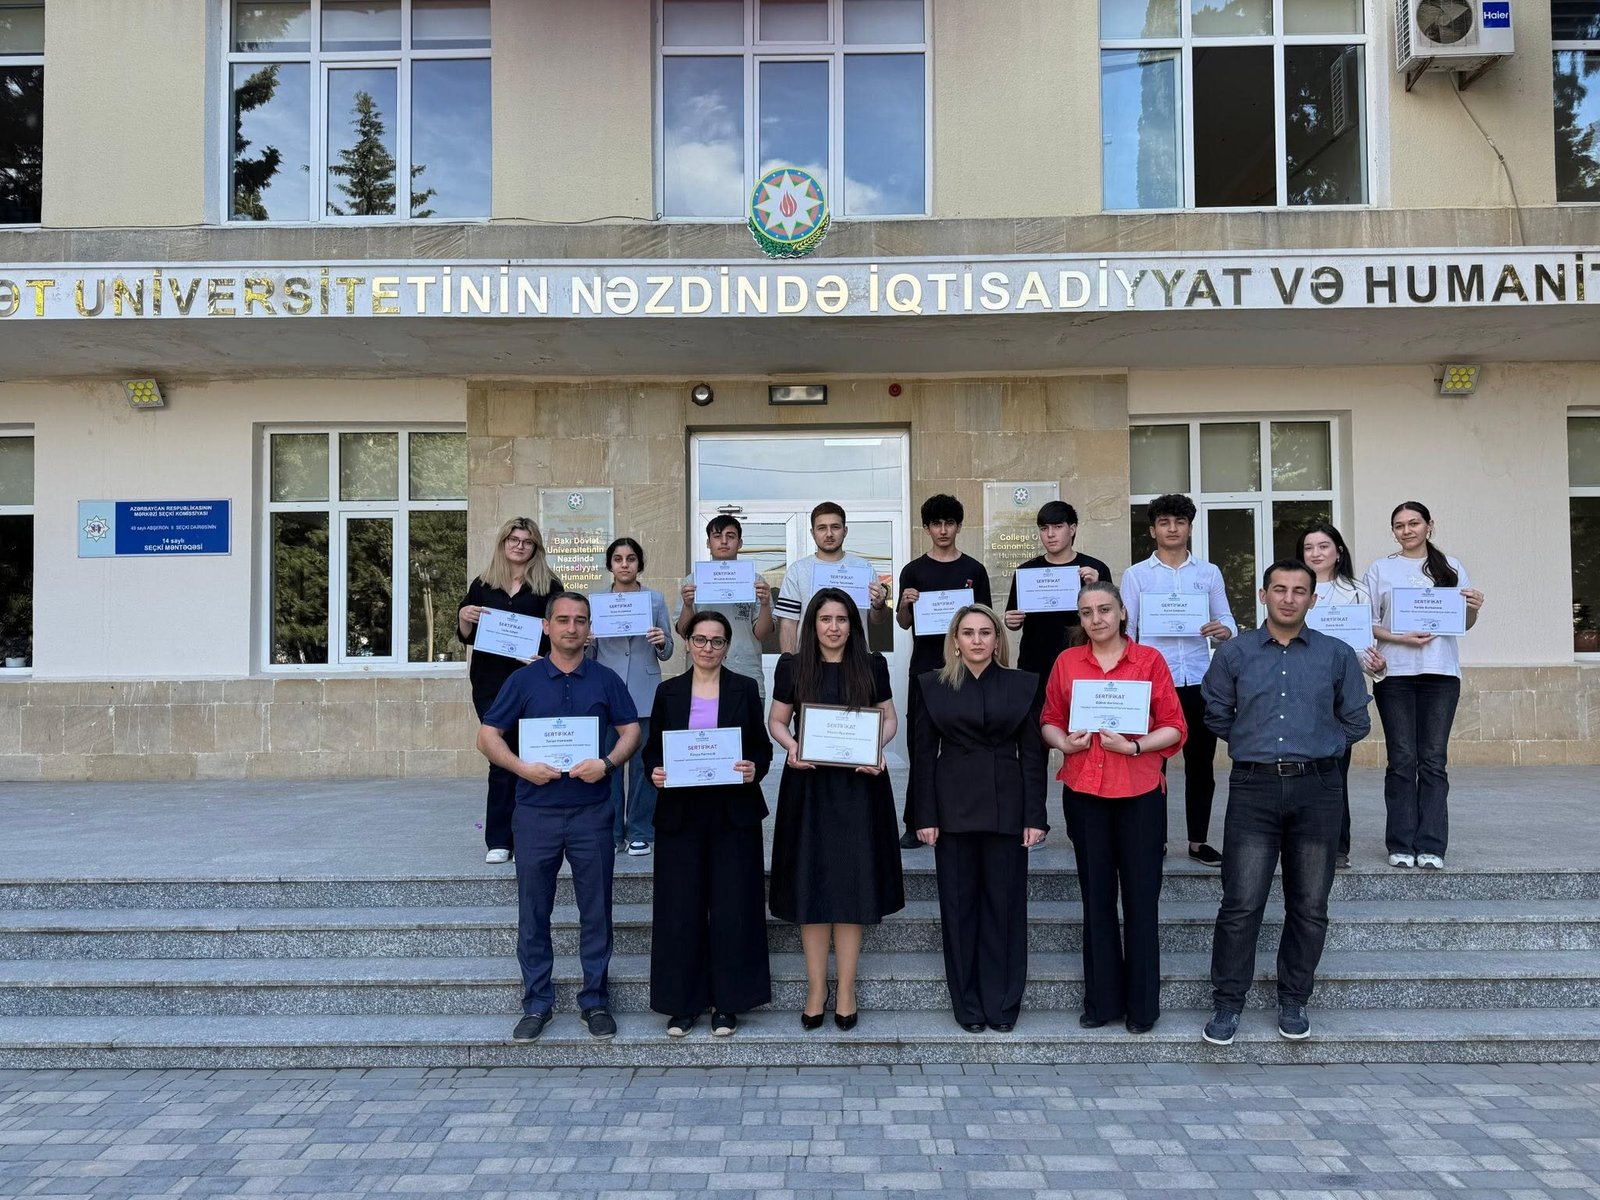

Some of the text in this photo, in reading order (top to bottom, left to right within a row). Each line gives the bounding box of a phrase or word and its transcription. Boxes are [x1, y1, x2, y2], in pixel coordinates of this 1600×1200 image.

[1484, 12, 1509, 20] Haier
[75, 266, 549, 317] UNİVERSİTETİNİN
[571, 265, 849, 315] NƏZDİNDƏ
[1270, 266, 1345, 306] VƏ
[1000, 533, 1030, 542] College
